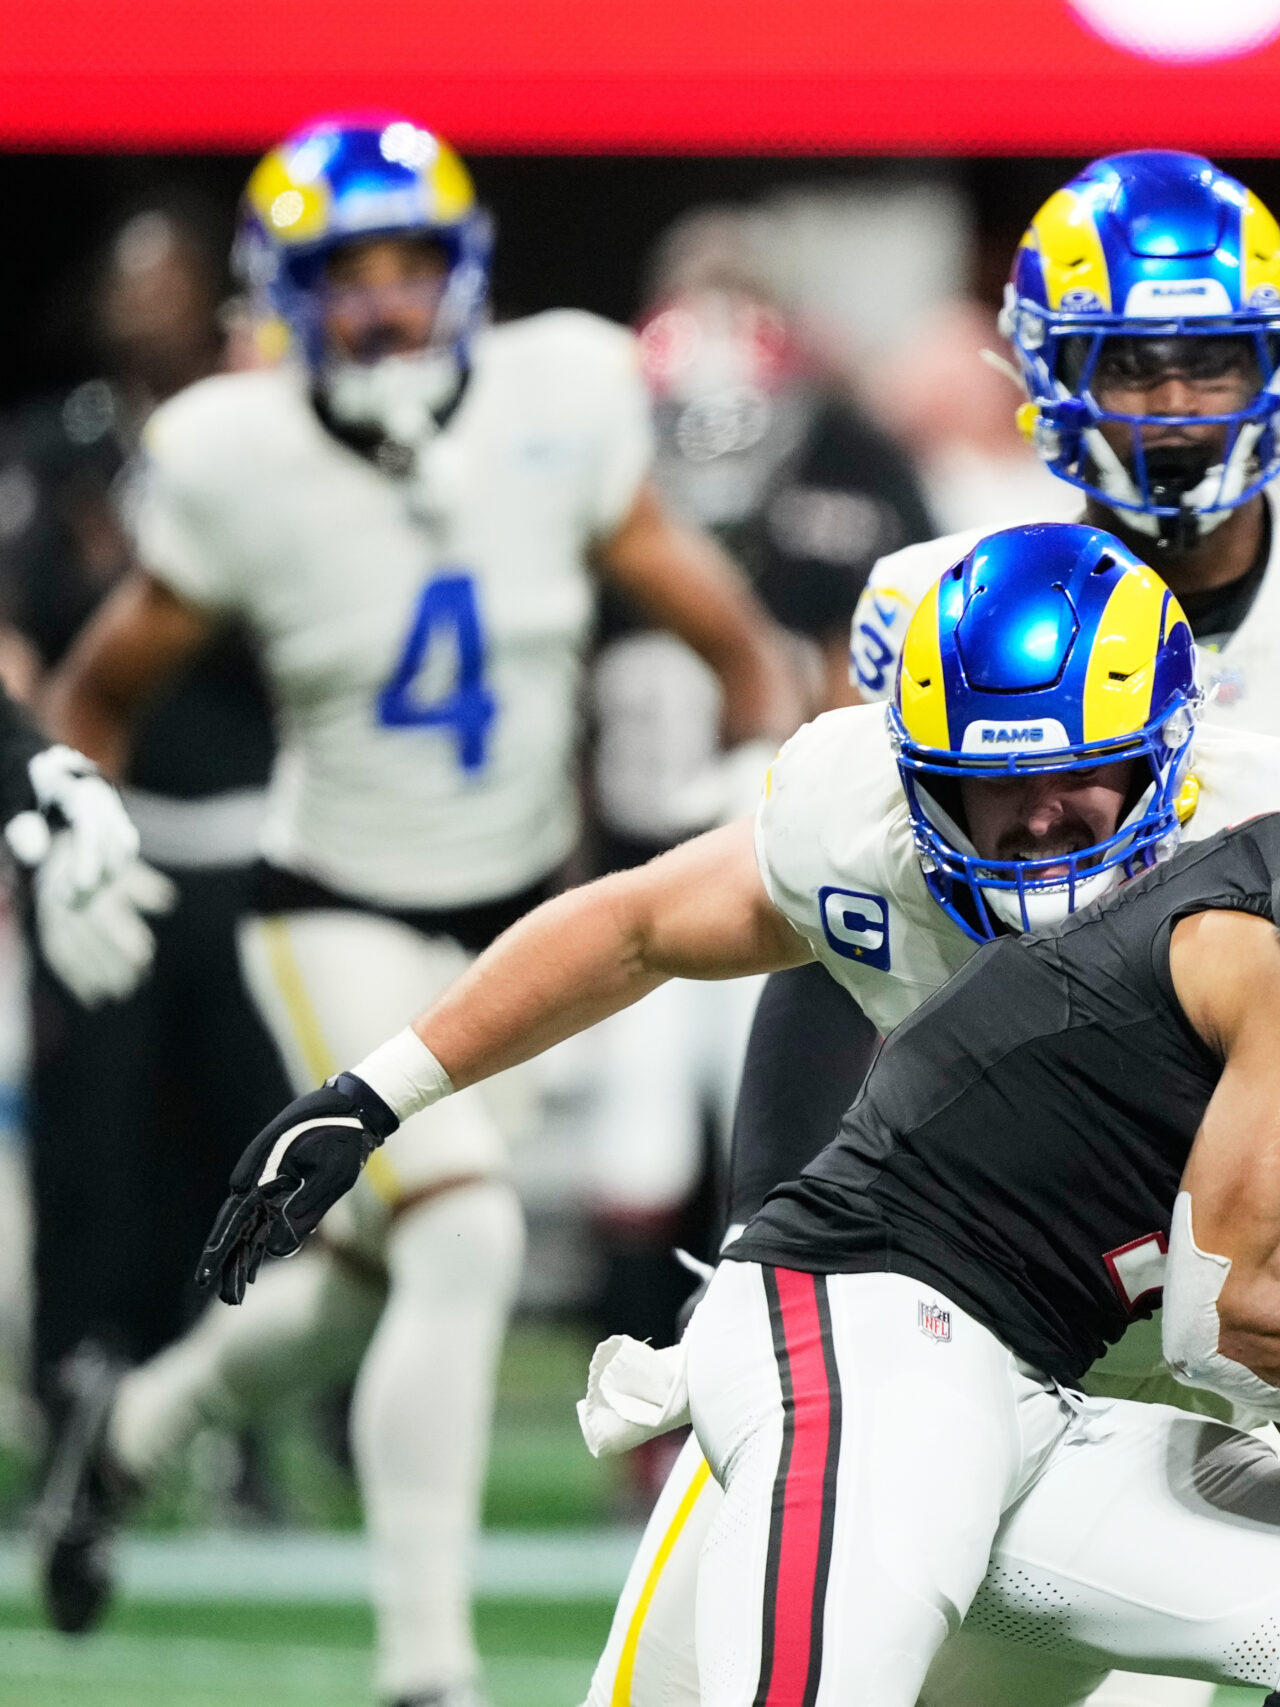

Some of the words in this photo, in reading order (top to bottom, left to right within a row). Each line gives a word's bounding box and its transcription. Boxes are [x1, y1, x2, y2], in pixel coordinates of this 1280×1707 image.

[379, 573, 496, 768] 4
[981, 727, 1044, 743] RAMS
[825, 893, 884, 951] C
[925, 1314, 948, 1337] NFL
